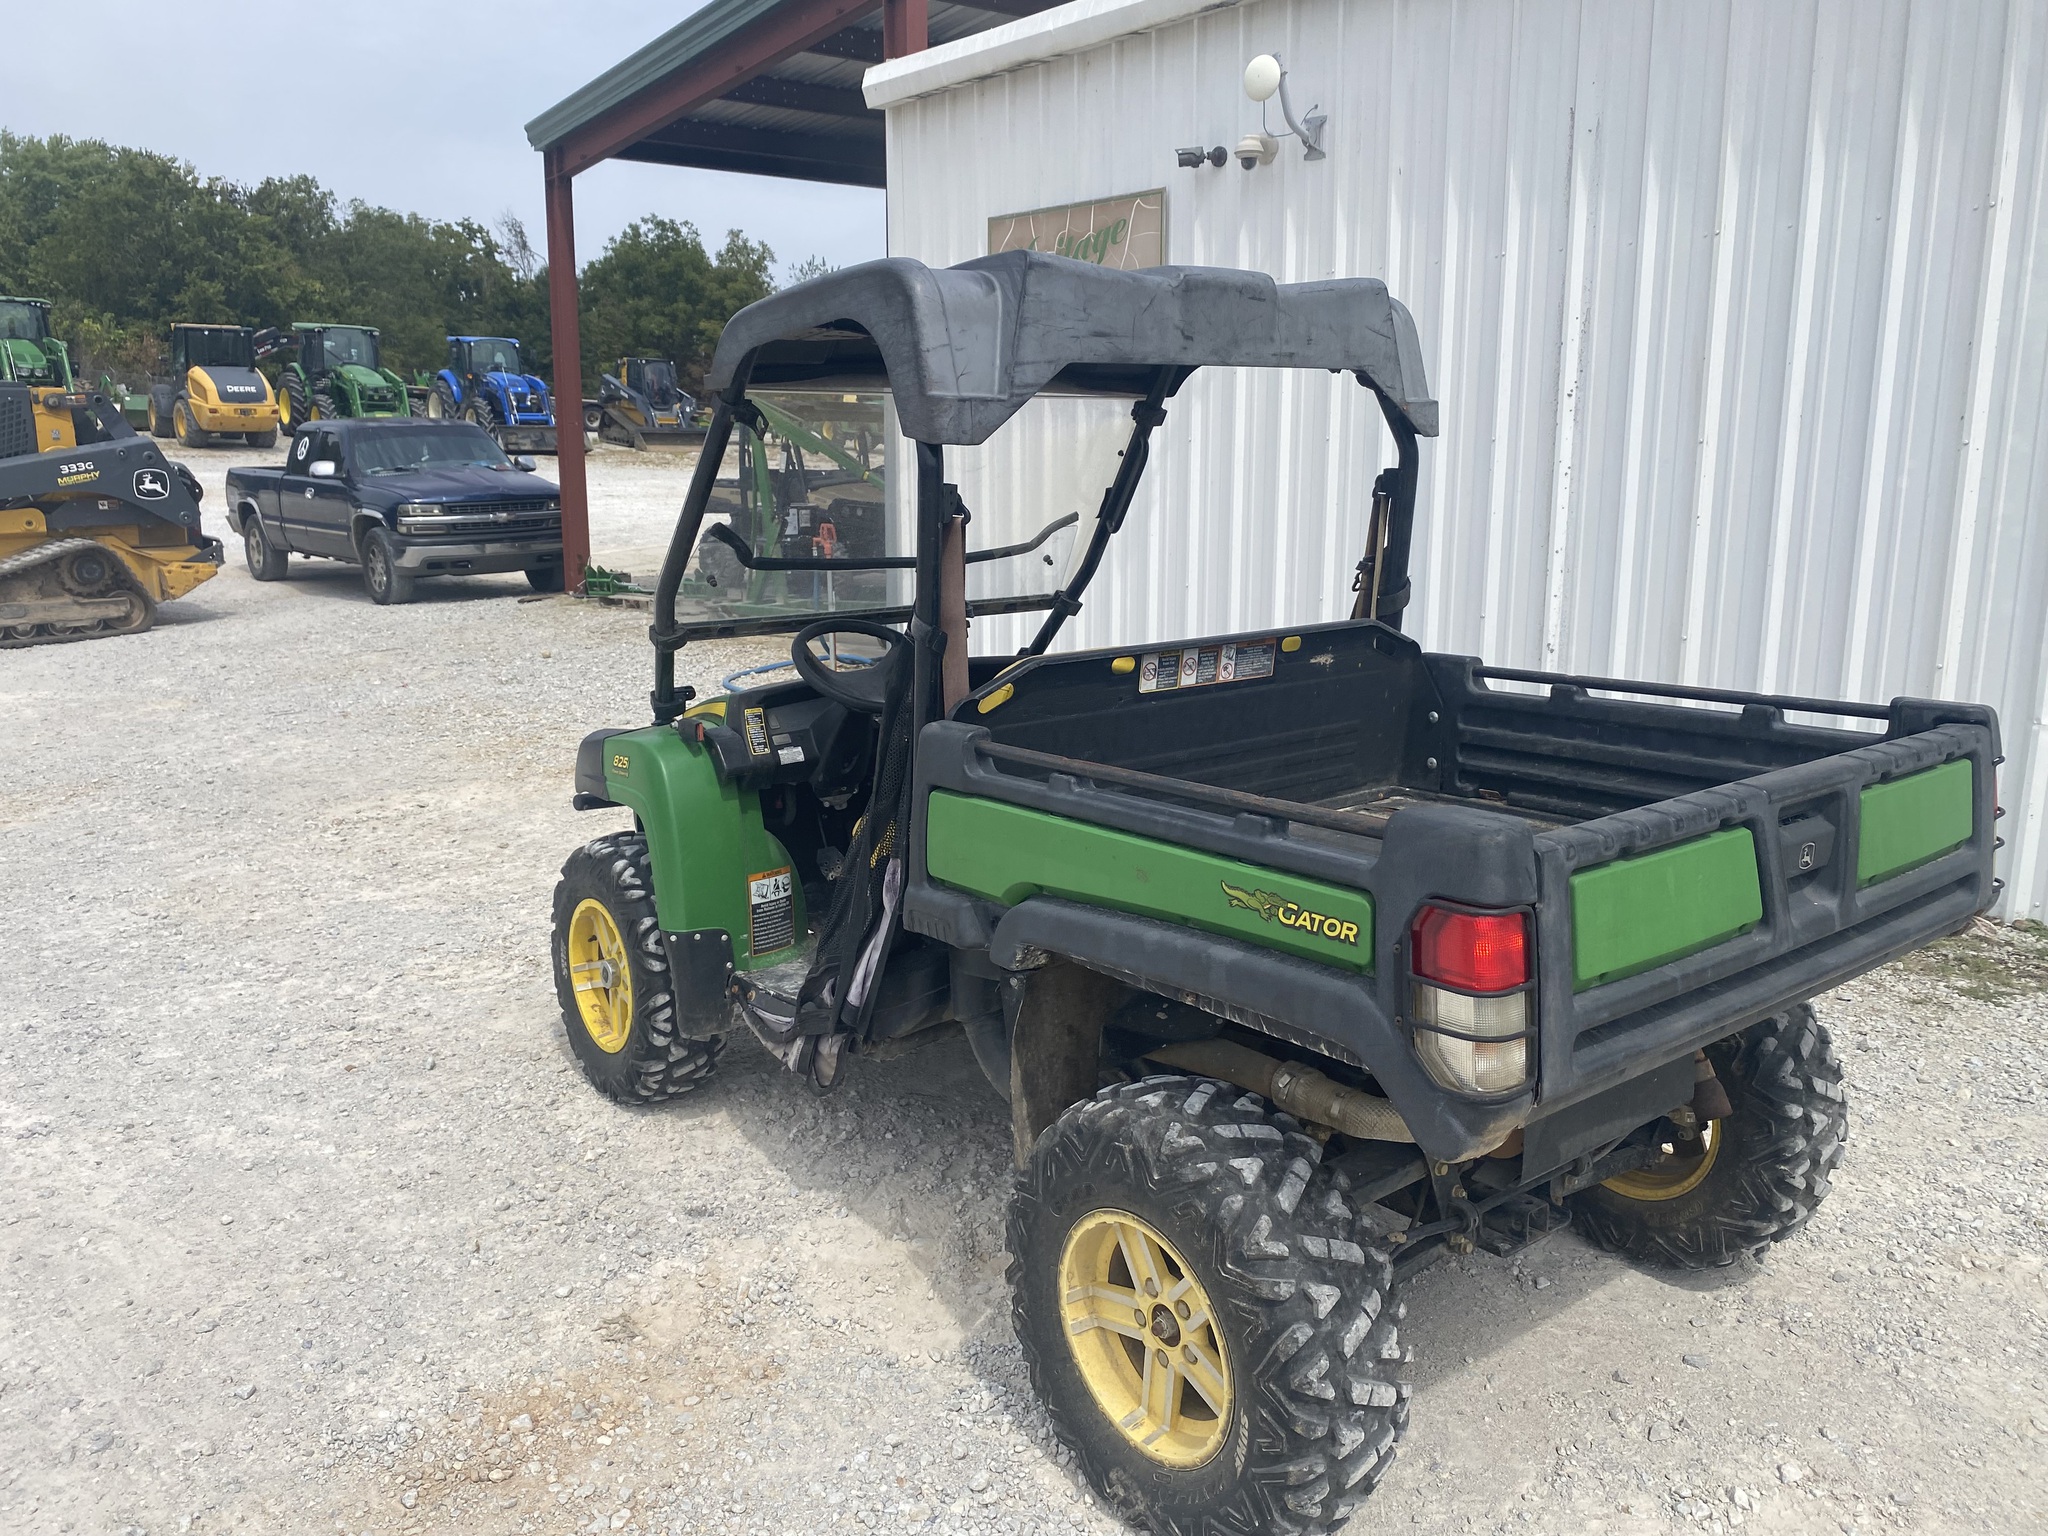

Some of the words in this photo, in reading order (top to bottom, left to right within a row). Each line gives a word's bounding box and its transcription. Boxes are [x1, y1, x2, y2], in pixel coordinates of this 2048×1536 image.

[226, 384, 257, 393] DEERE
[60, 461, 94, 474] 333G
[57, 470, 100, 485] MURPHY
[1277, 902, 1359, 945] GATOR
